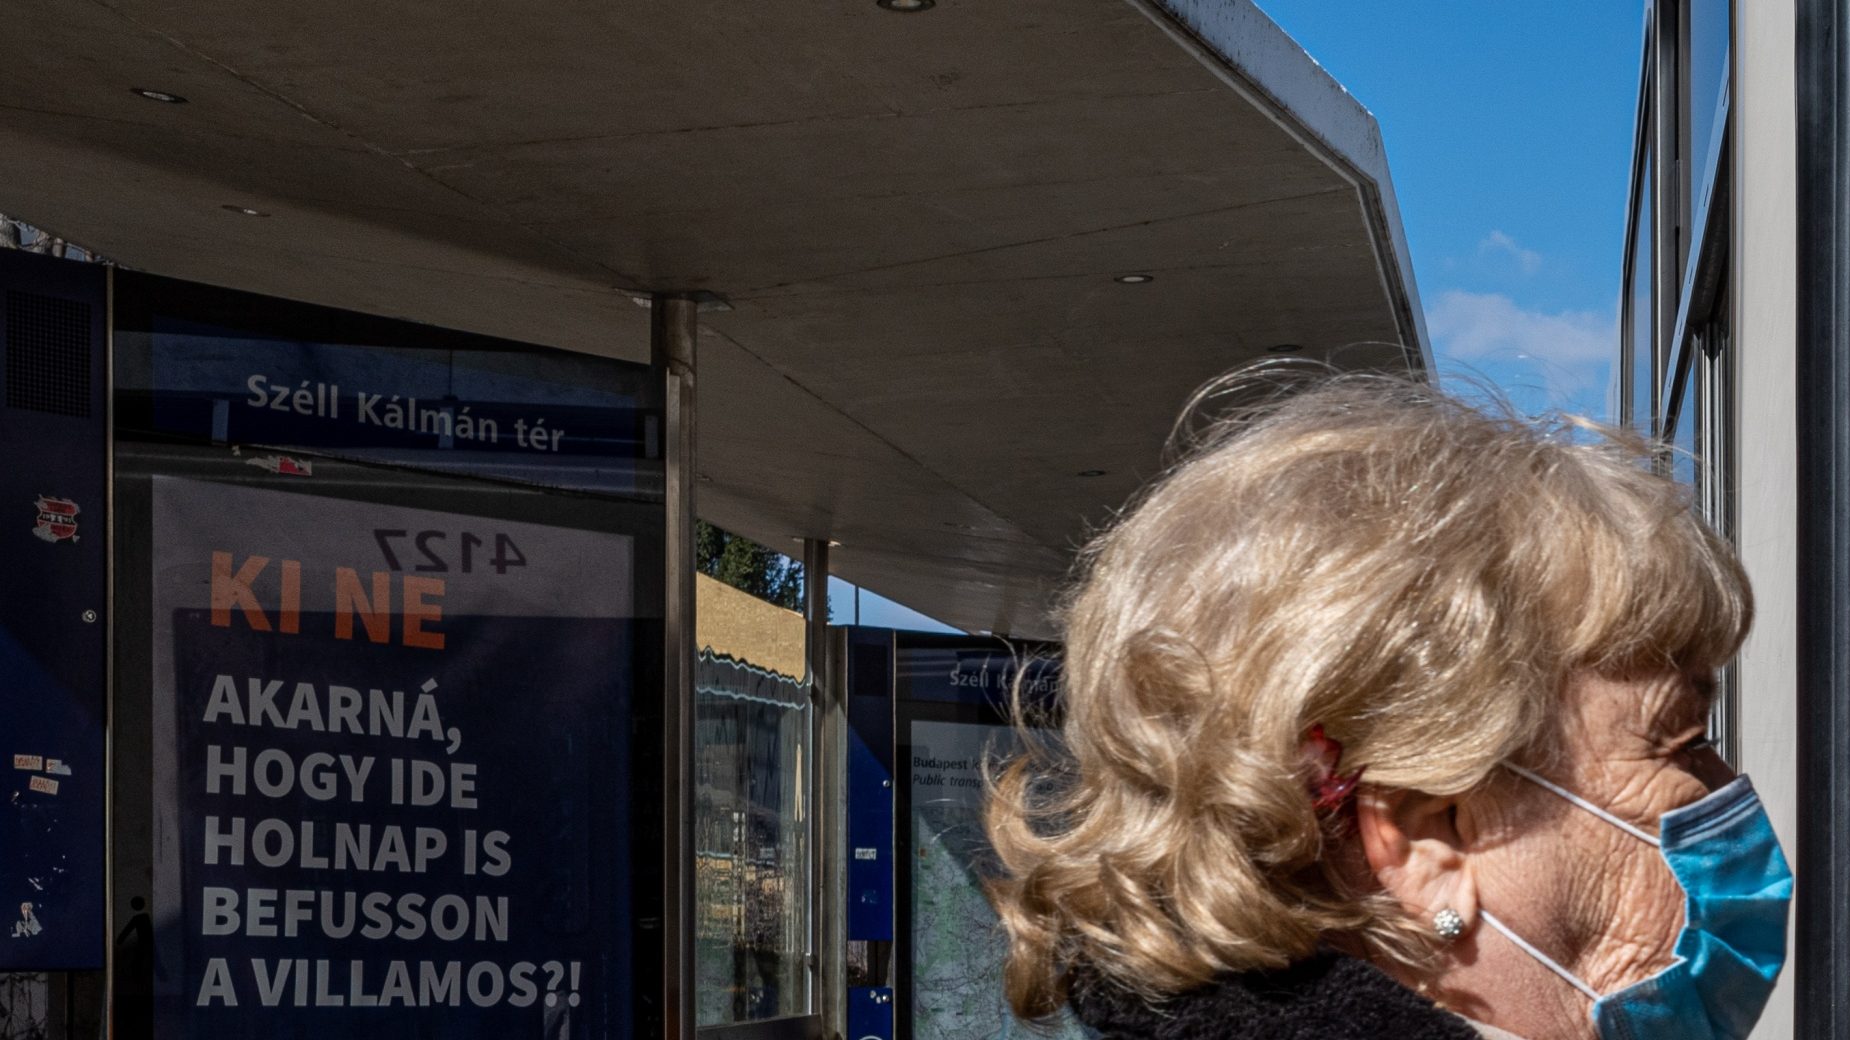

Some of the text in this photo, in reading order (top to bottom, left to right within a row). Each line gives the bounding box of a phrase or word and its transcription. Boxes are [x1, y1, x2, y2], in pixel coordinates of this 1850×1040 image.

[246, 373, 565, 453] Széll Kálmán tér
[210, 550, 446, 651] KI NE
[949, 669, 989, 688] Széll
[202, 673, 462, 755] AKARNÁ,
[205, 744, 479, 810] HOGY IDE
[912, 774, 945, 787] Public
[913, 756, 968, 771] Budapest
[203, 815, 513, 878] HOLNAP IS
[201, 886, 509, 943] BEFUSSON
[195, 957, 583, 1009] A VILLAMOS?!
